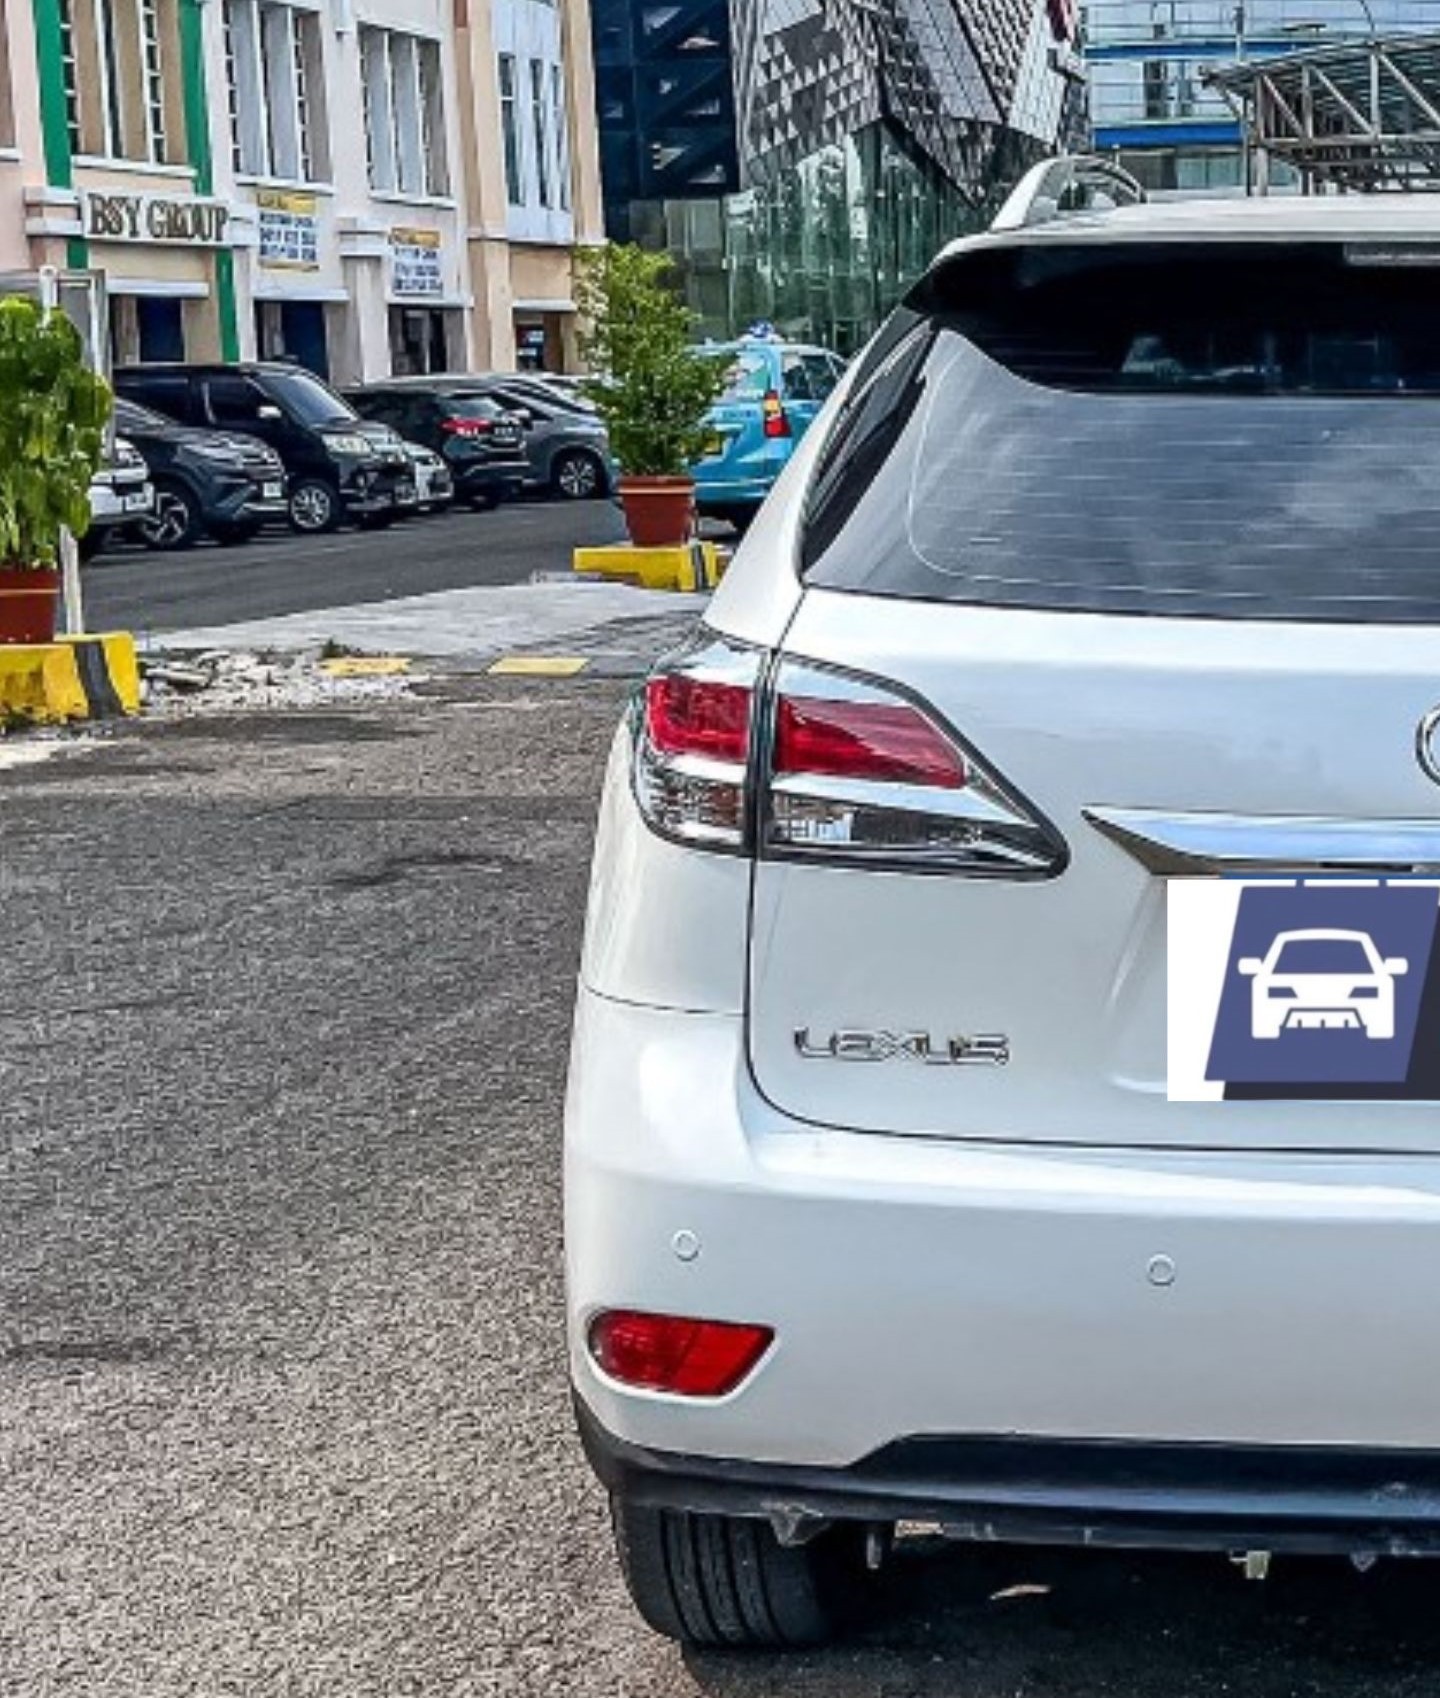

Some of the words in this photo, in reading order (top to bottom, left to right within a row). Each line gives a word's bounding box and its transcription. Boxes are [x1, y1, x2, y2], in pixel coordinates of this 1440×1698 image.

[88, 192, 143, 238] BSY
[147, 200, 229, 242] GROUP
[794, 1026, 1010, 1066] LEXUS
